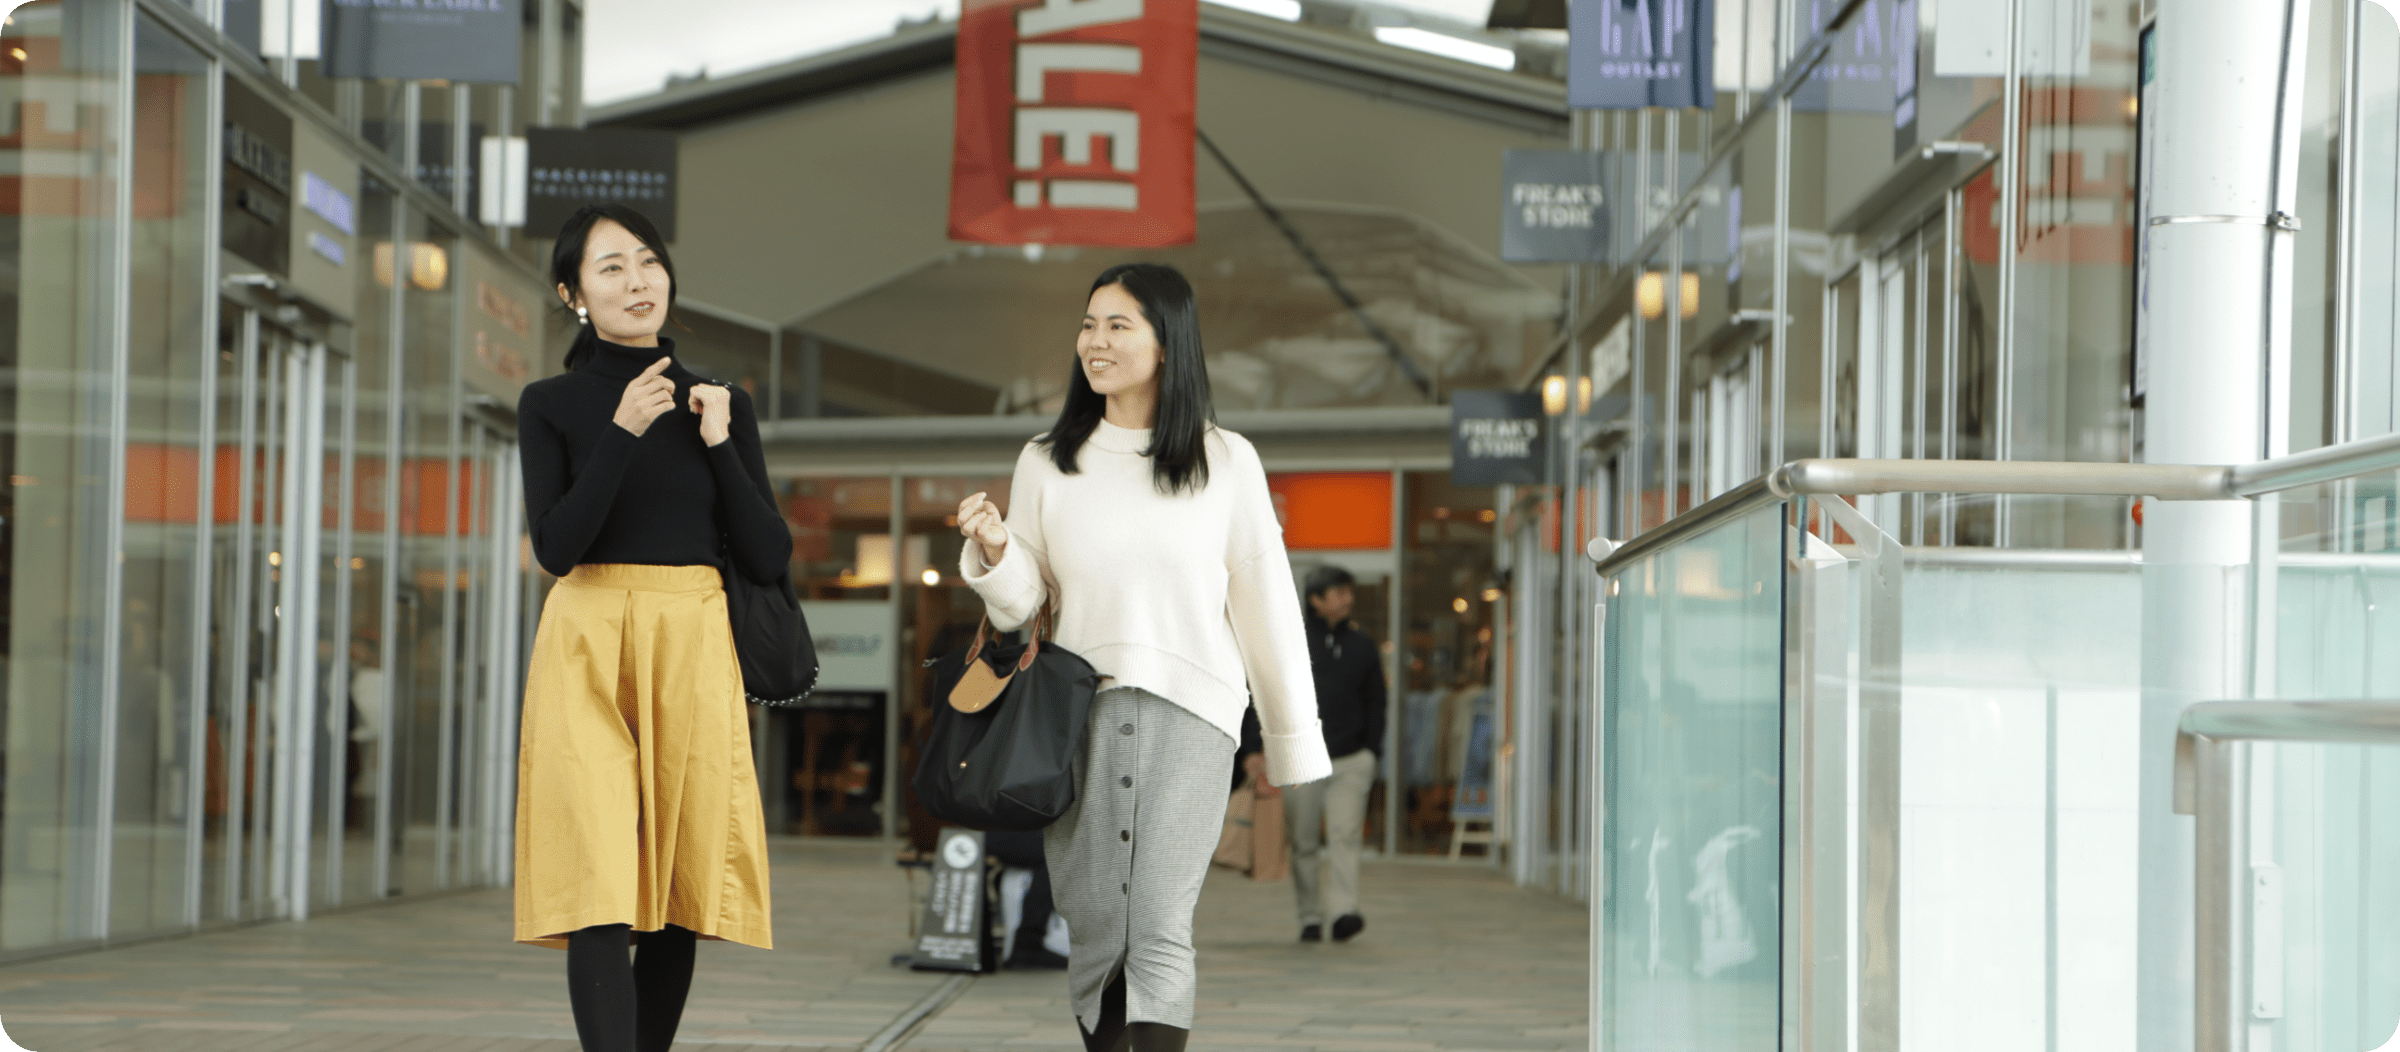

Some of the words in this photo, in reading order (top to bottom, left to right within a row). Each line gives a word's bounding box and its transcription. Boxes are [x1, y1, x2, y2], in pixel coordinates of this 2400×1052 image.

[1601, 61, 1681, 79] OUTLET
[1522, 205, 1593, 228] STORE
[1467, 438, 1531, 459] STORE
